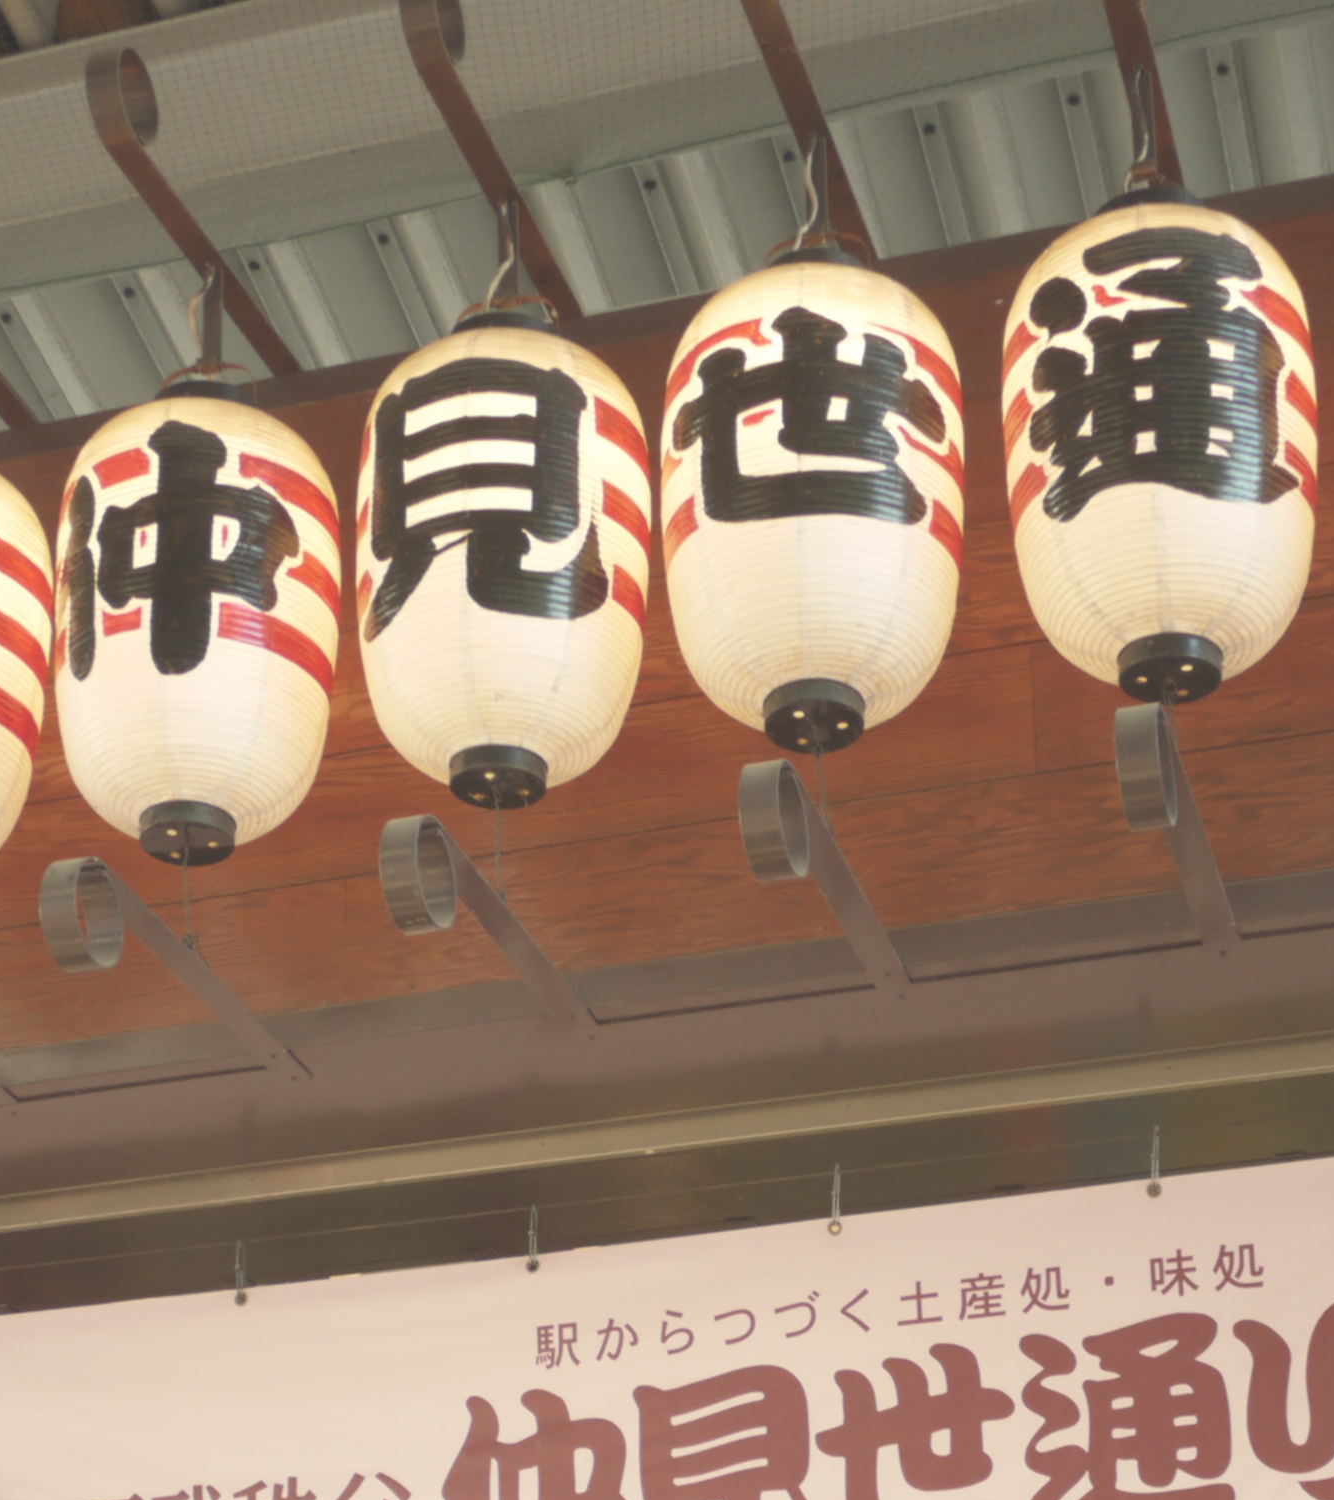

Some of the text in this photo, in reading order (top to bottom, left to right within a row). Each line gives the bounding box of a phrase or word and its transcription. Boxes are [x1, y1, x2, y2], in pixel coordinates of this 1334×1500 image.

[63, 421, 300, 676] 仲
[366, 359, 610, 642] 見
[672, 307, 946, 524] 世
[1025, 229, 1305, 522] 通
[534, 1239, 1270, 1371] 駅からつづく土産処・味処
